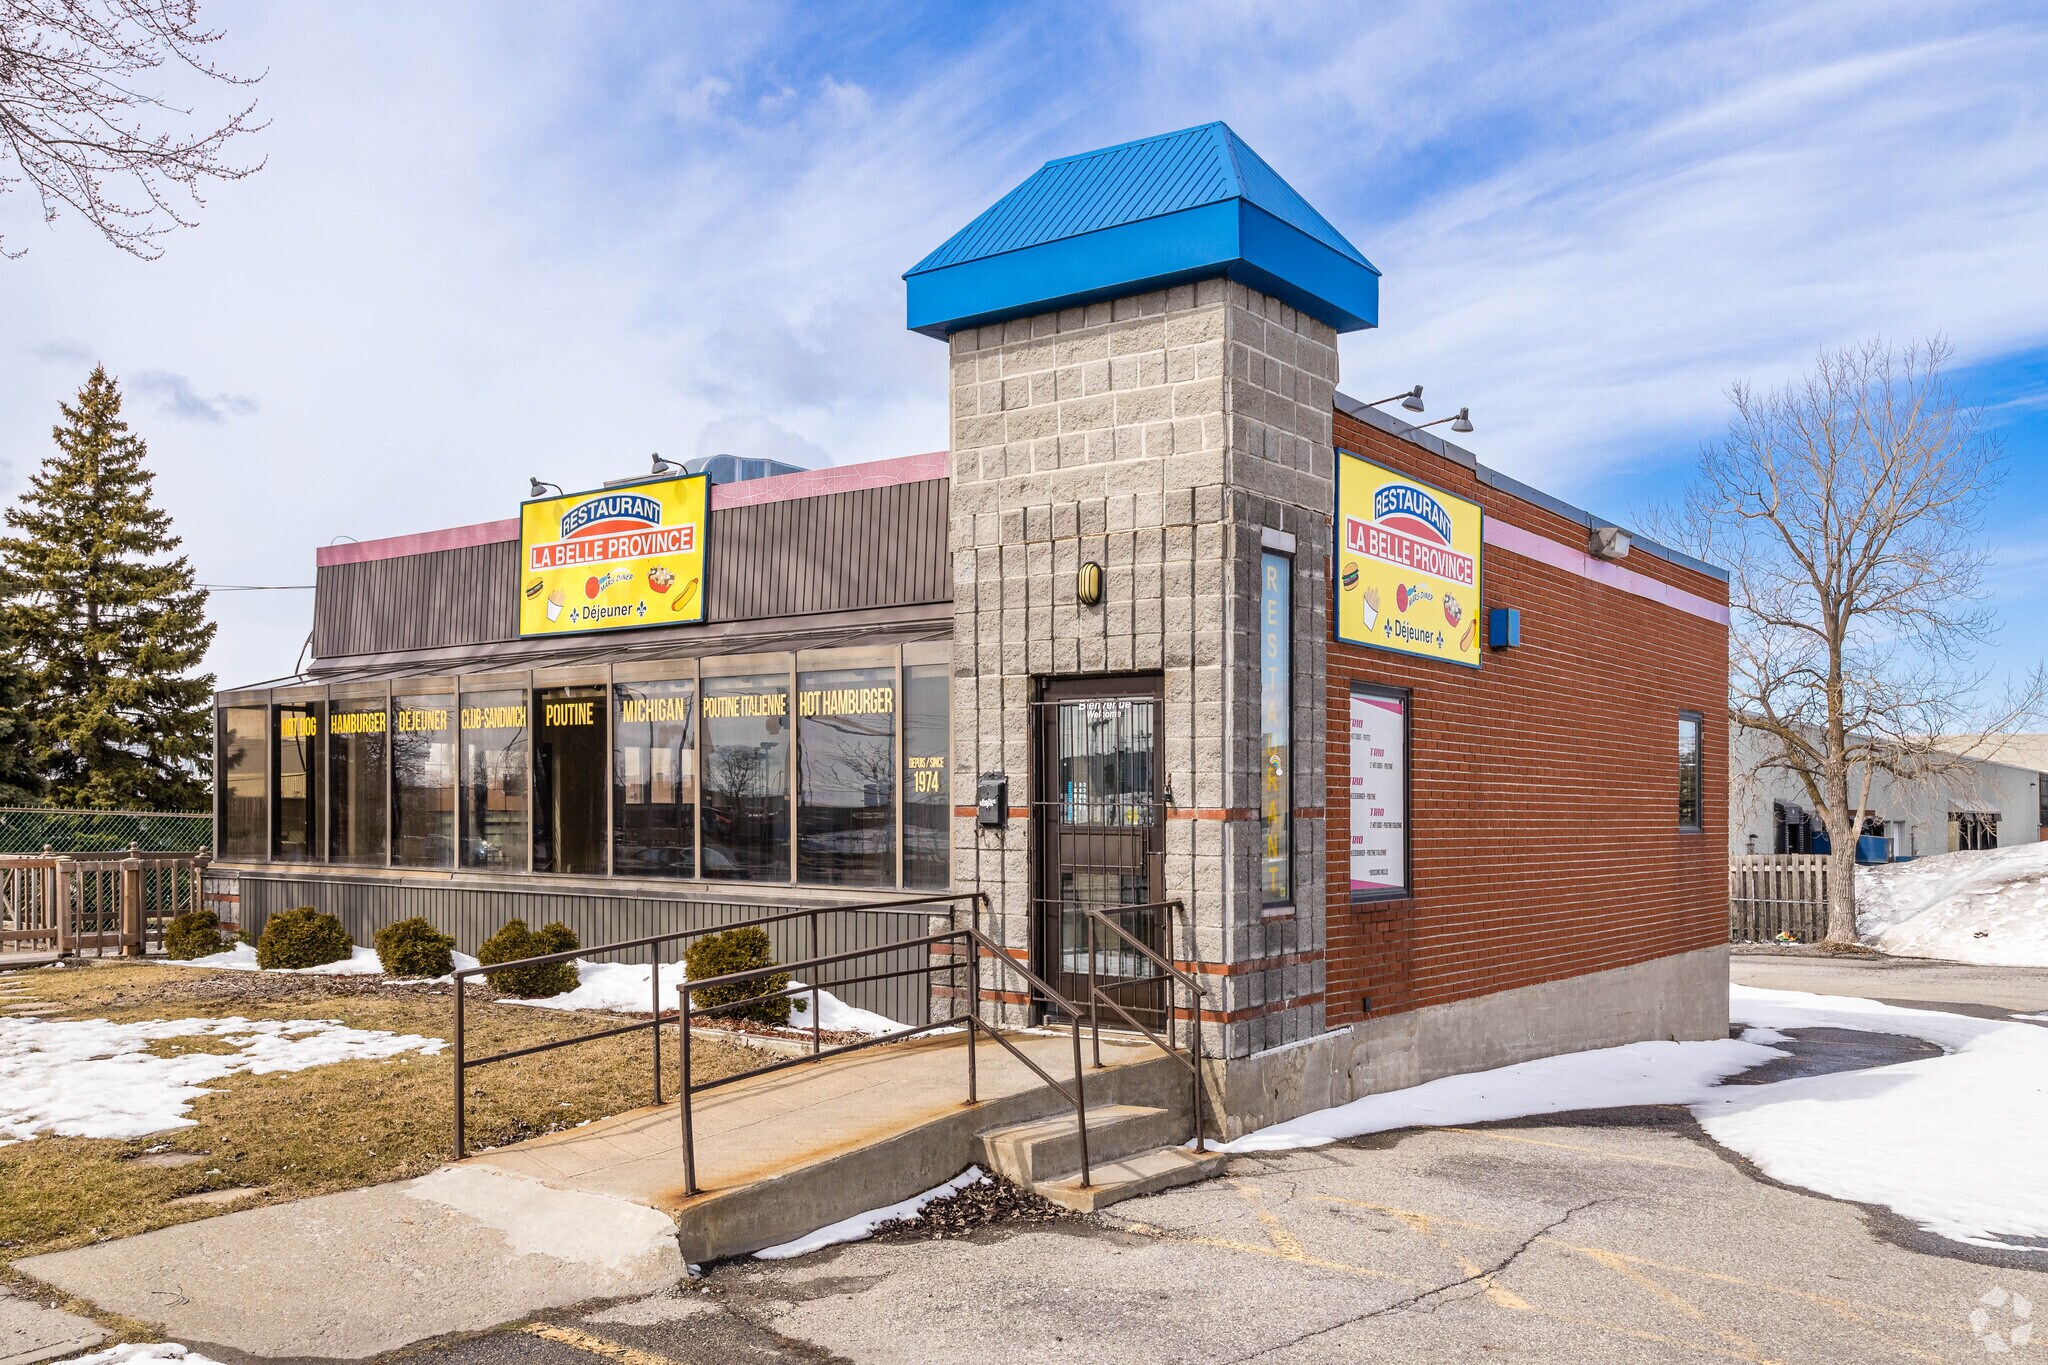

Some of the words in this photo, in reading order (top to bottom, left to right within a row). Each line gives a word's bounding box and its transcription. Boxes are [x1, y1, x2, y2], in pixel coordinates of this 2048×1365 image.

[563, 496, 660, 534] RESTAURANT
[1376, 488, 1451, 541] RESTAURANT
[532, 547, 551, 569] LA
[555, 541, 603, 566] BELLE
[608, 528, 691, 560] PROVINCE
[1348, 521, 1366, 551] LA
[1370, 529, 1411, 566] BELLE
[1413, 544, 1472, 583] PROVINCE
[582, 603, 633, 622] Déjeuner
[1395, 619, 1434, 644] Déjeuner
[546, 702, 594, 727] POUTINE
[623, 697, 684, 723] MICHIGAN
[703, 695, 740, 718] POUTINE
[741, 693, 787, 717] ITALIENNE
[799, 690, 821, 717] HOT
[822, 687, 893, 715] HAMBURGER
[281, 717, 298, 737] HOT
[300, 716, 317, 737] DOG
[331, 712, 386, 734] HAMBURGER
[399, 703, 447, 731] DÉJEUNER
[461, 705, 527, 730] CLUB-SANDWICH
[1266, 565, 1279, 892] RESTAURANT
[930, 756, 945, 768] SINCE
[1370, 748, 1384, 757] TRIO
[913, 770, 939, 793] 1974
[1370, 807, 1384, 817] TRIO
